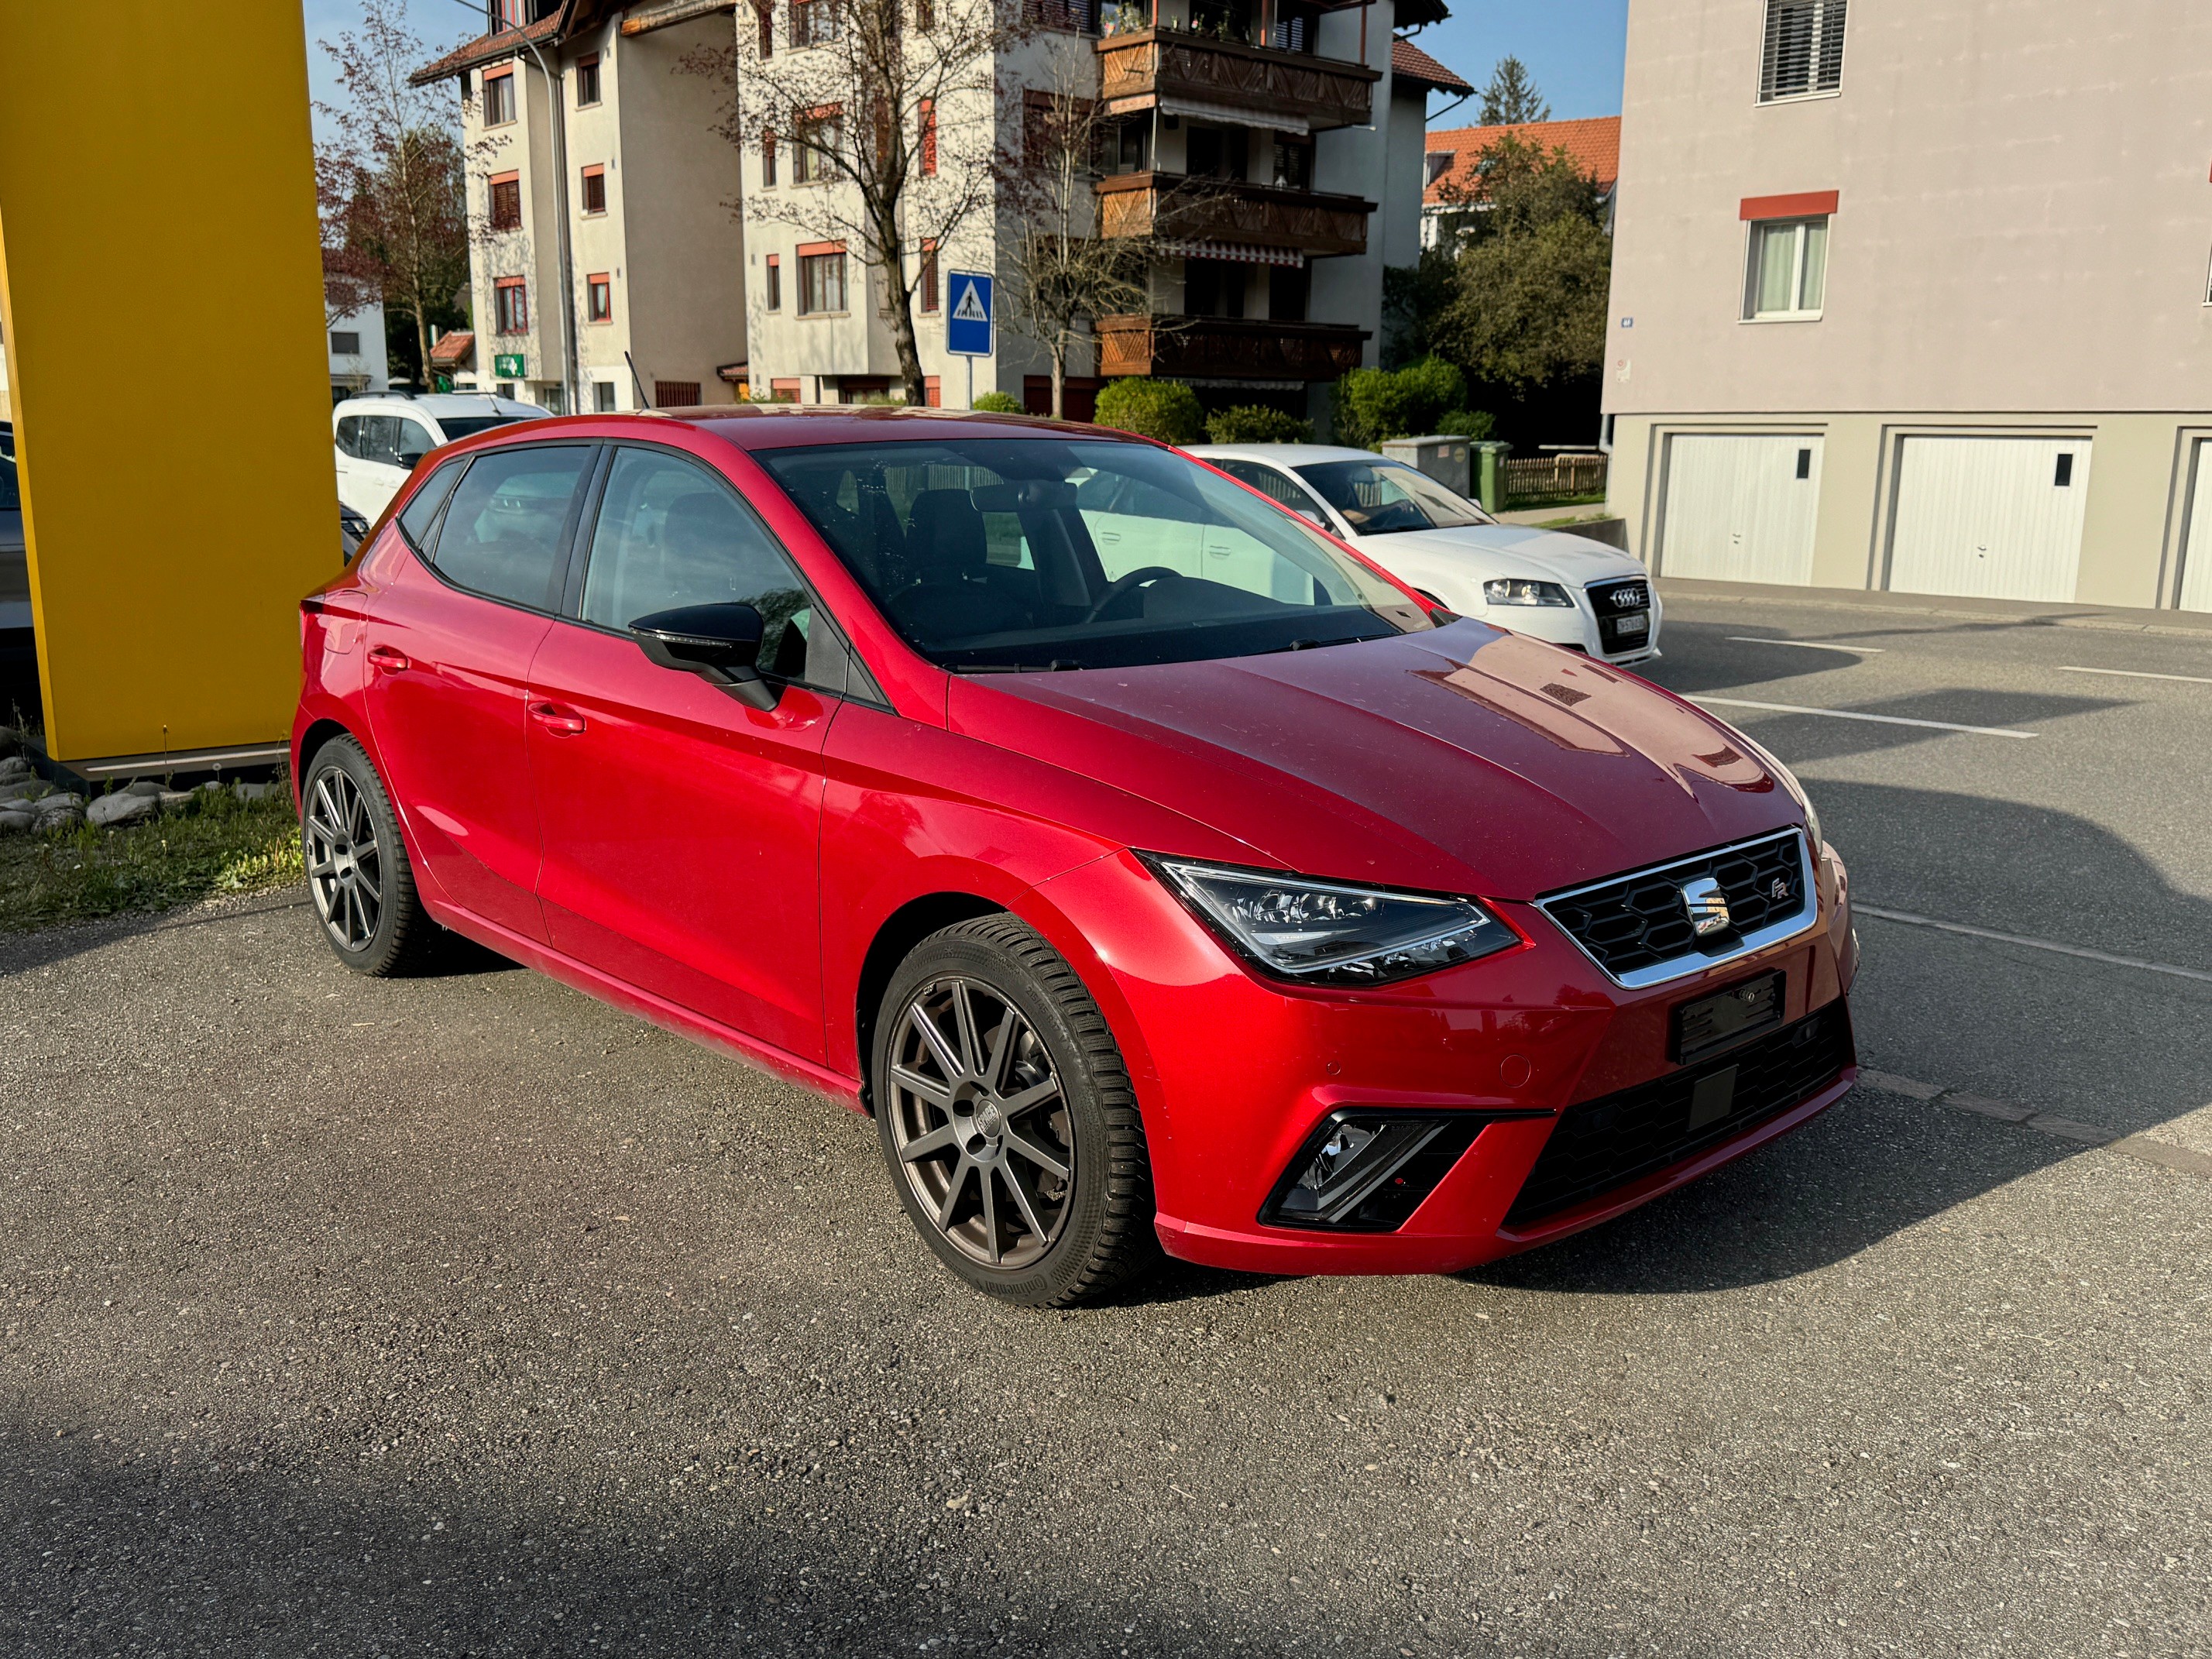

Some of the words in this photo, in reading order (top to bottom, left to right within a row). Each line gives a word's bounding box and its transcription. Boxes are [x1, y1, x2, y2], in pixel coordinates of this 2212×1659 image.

[1771, 878, 1789, 899] FR
[1025, 986, 1046, 1015] 215/45
[978, 1104, 996, 1130] SPACE
[984, 1273, 1048, 1296] Continental
